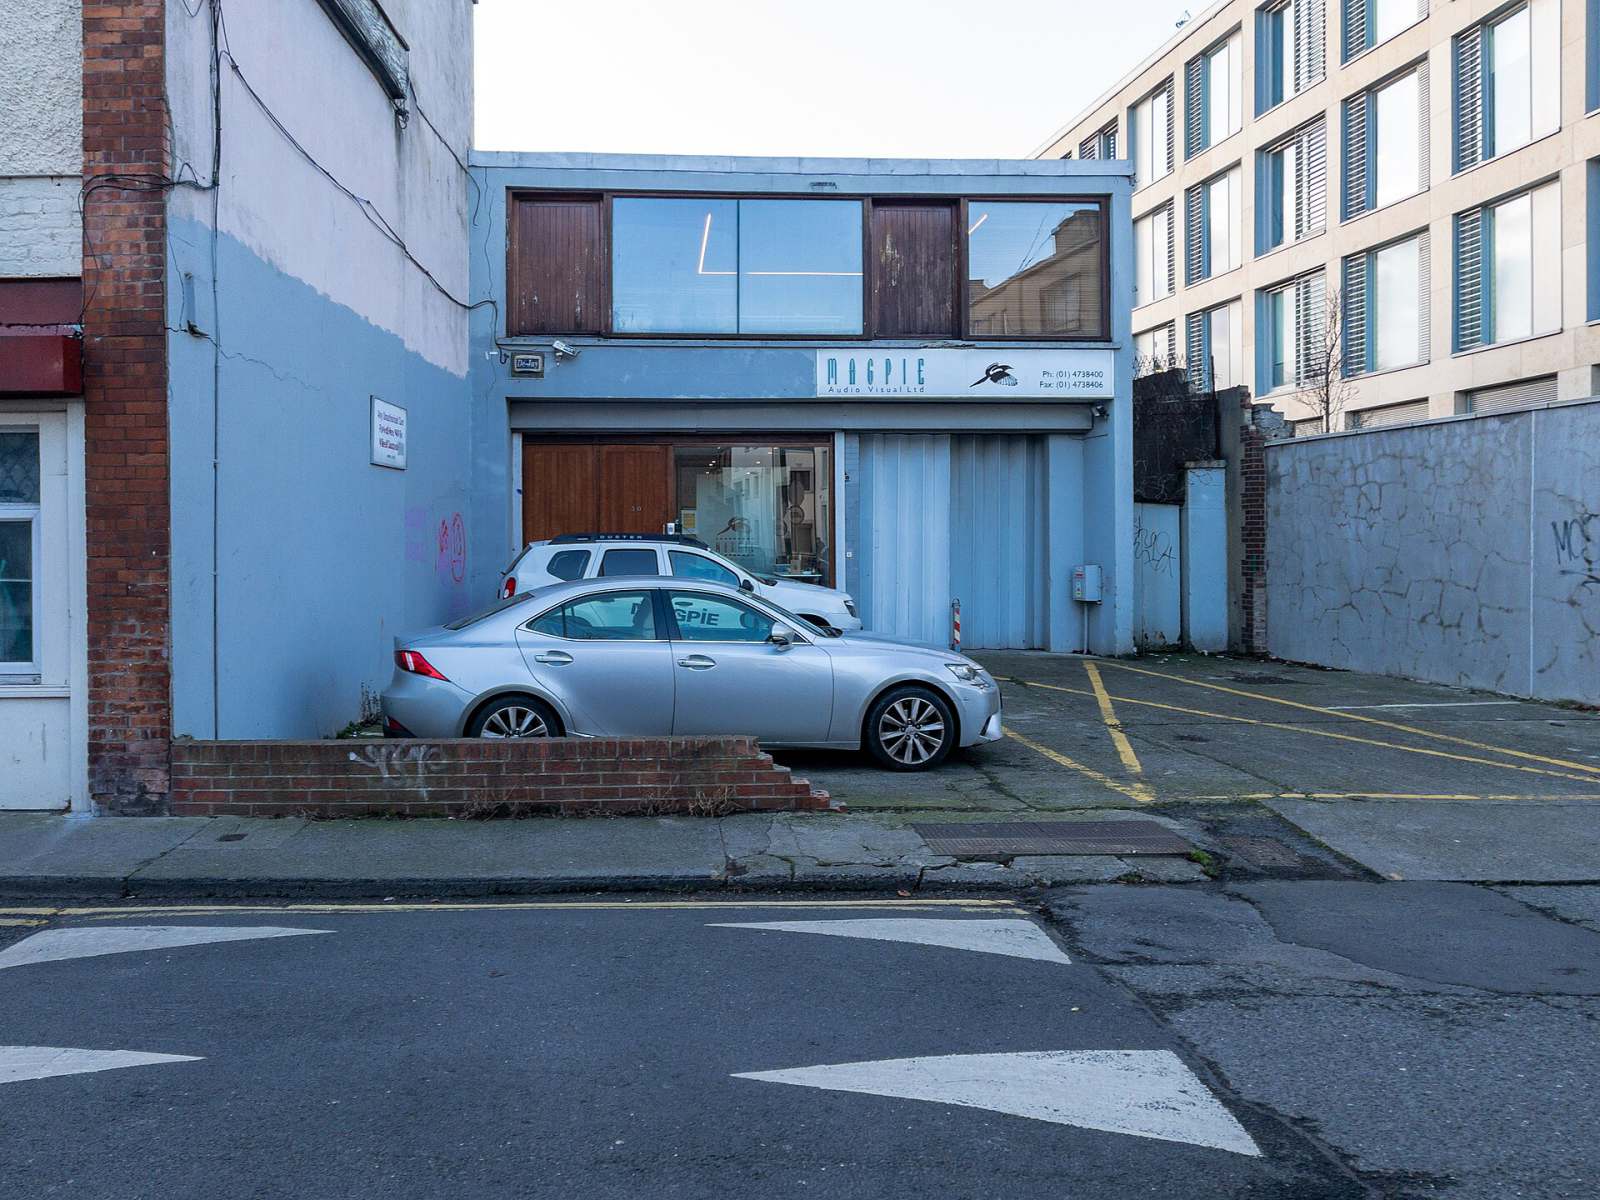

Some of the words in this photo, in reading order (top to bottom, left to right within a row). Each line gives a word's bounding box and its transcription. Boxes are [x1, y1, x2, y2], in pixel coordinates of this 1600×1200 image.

[827, 358, 924, 385] MAGPIE
[1043, 370, 1054, 378] Ph:
[1056, 370, 1070, 379] (01)
[1072, 370, 1104, 378] 4738400
[1039, 380, 1054, 388] Fax:
[1056, 380, 1070, 389] (01)
[1072, 380, 1104, 389] 4738406
[828, 386, 861, 394] Audio
[868, 386, 902, 394] Visual
[906, 386, 925, 394] Ltd
